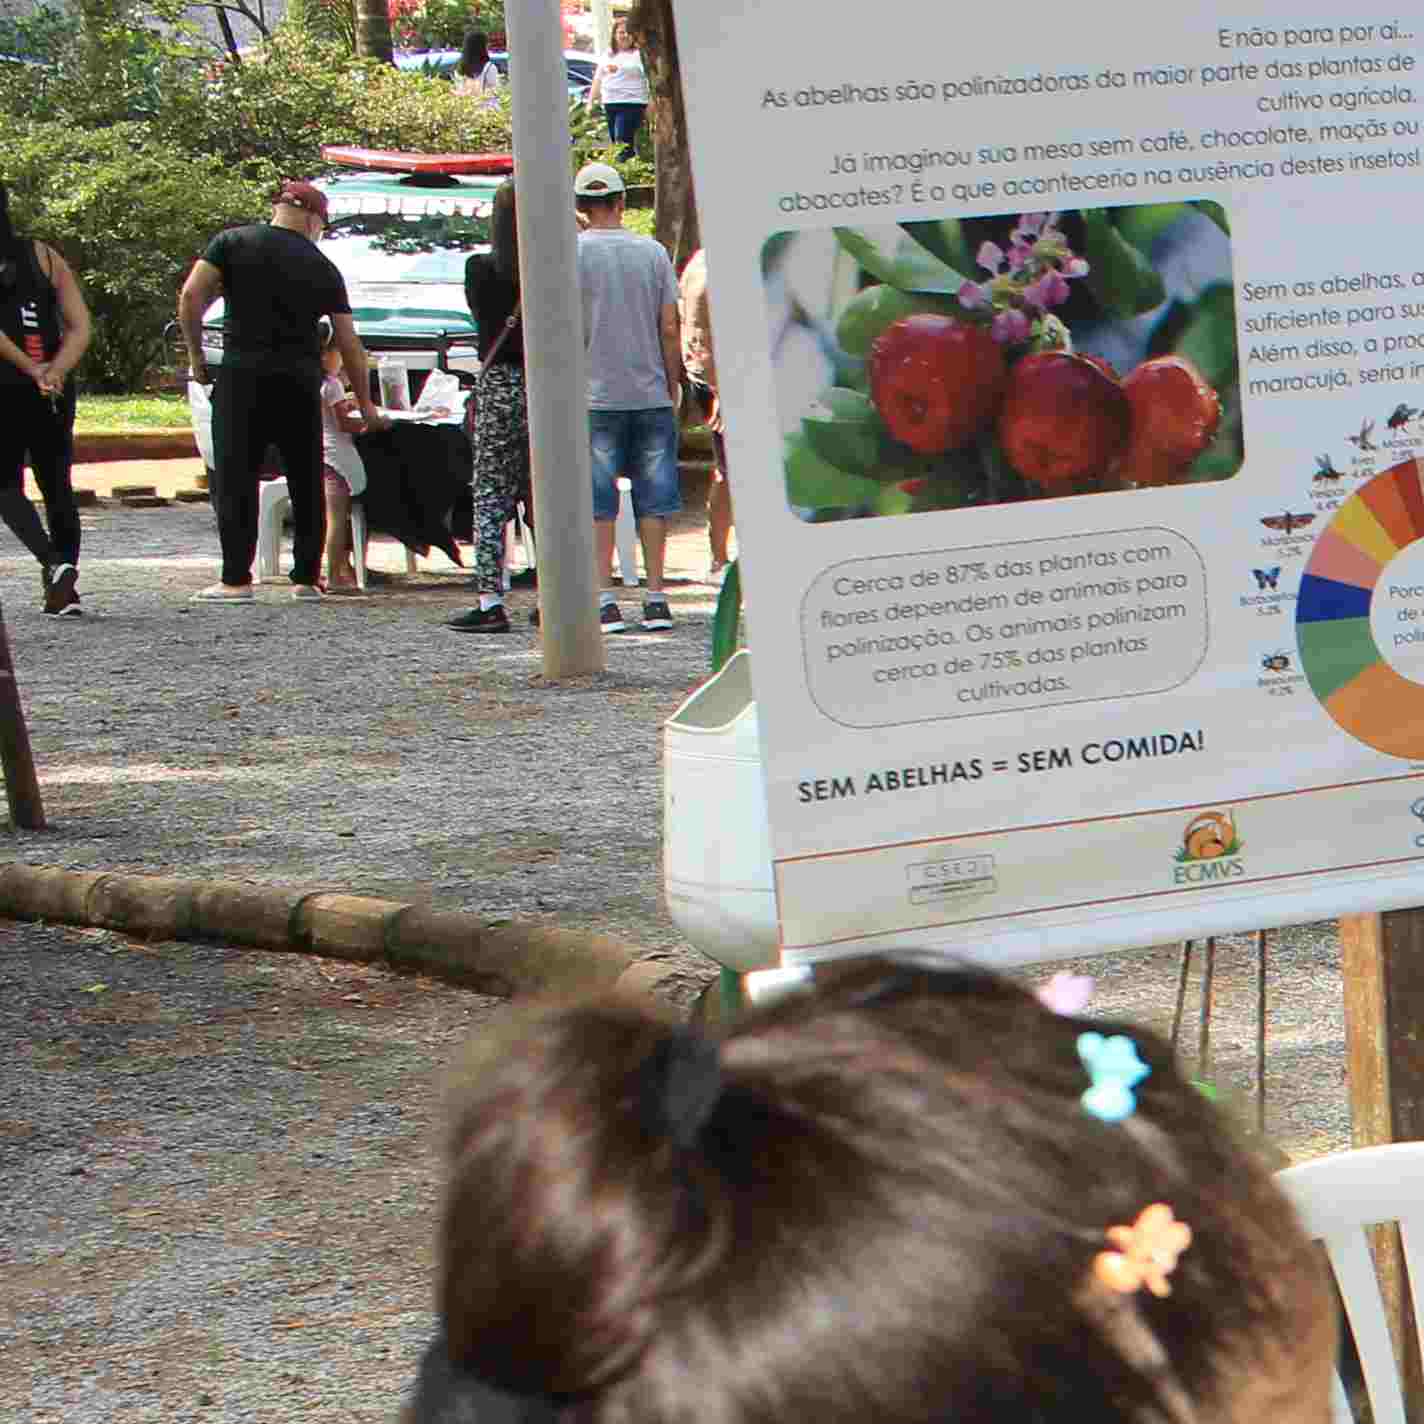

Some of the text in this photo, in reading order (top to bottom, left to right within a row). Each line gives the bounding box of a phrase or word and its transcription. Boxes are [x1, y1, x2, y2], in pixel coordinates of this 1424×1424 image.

[1217, 28, 1233, 49] E
[1235, 27, 1278, 49] não
[1283, 27, 1334, 49] para
[1339, 25, 1374, 48] por
[761, 51, 1416, 108] As abelhas são polinizadoras da maior parte das plantas de
[1256, 84, 1417, 113] cultivo agrícola.
[829, 118, 1419, 175] Já imaginou sua mesa sem café, chocolate, maçãs ou
[778, 148, 1421, 212] abacates? É o que aconteceria na ausência destes insetos!
[328, 198, 493, 219] MBIENTA
[1242, 282, 1290, 303] Sem
[1291, 281, 1316, 298] as
[1318, 272, 1410, 297] abelhas,
[1244, 306, 1343, 333] suficiente
[1342, 303, 1397, 329] para
[1248, 343, 1301, 367] Além
[1303, 335, 1362, 361] disso,
[1363, 337, 1379, 353] a
[1249, 367, 1353, 394] maracujá,
[1357, 359, 1405, 385] seria
[831, 543, 1172, 598] Cerca de 87% das plantas com
[820, 573, 1188, 628] flores dependem de animais para
[1397, 607, 1419, 623] de
[826, 600, 1187, 662] polinização. Os animais polinizam
[872, 634, 1149, 684] cerca de 75% das plantas
[956, 673, 1073, 703] cultivadas.
[797, 777, 857, 803] SEM
[863, 759, 984, 793] ABELHAS
[1017, 747, 1073, 774] SEM
[1080, 731, 1204, 765] COMIDA!
[1173, 857, 1246, 885] ECMVS
